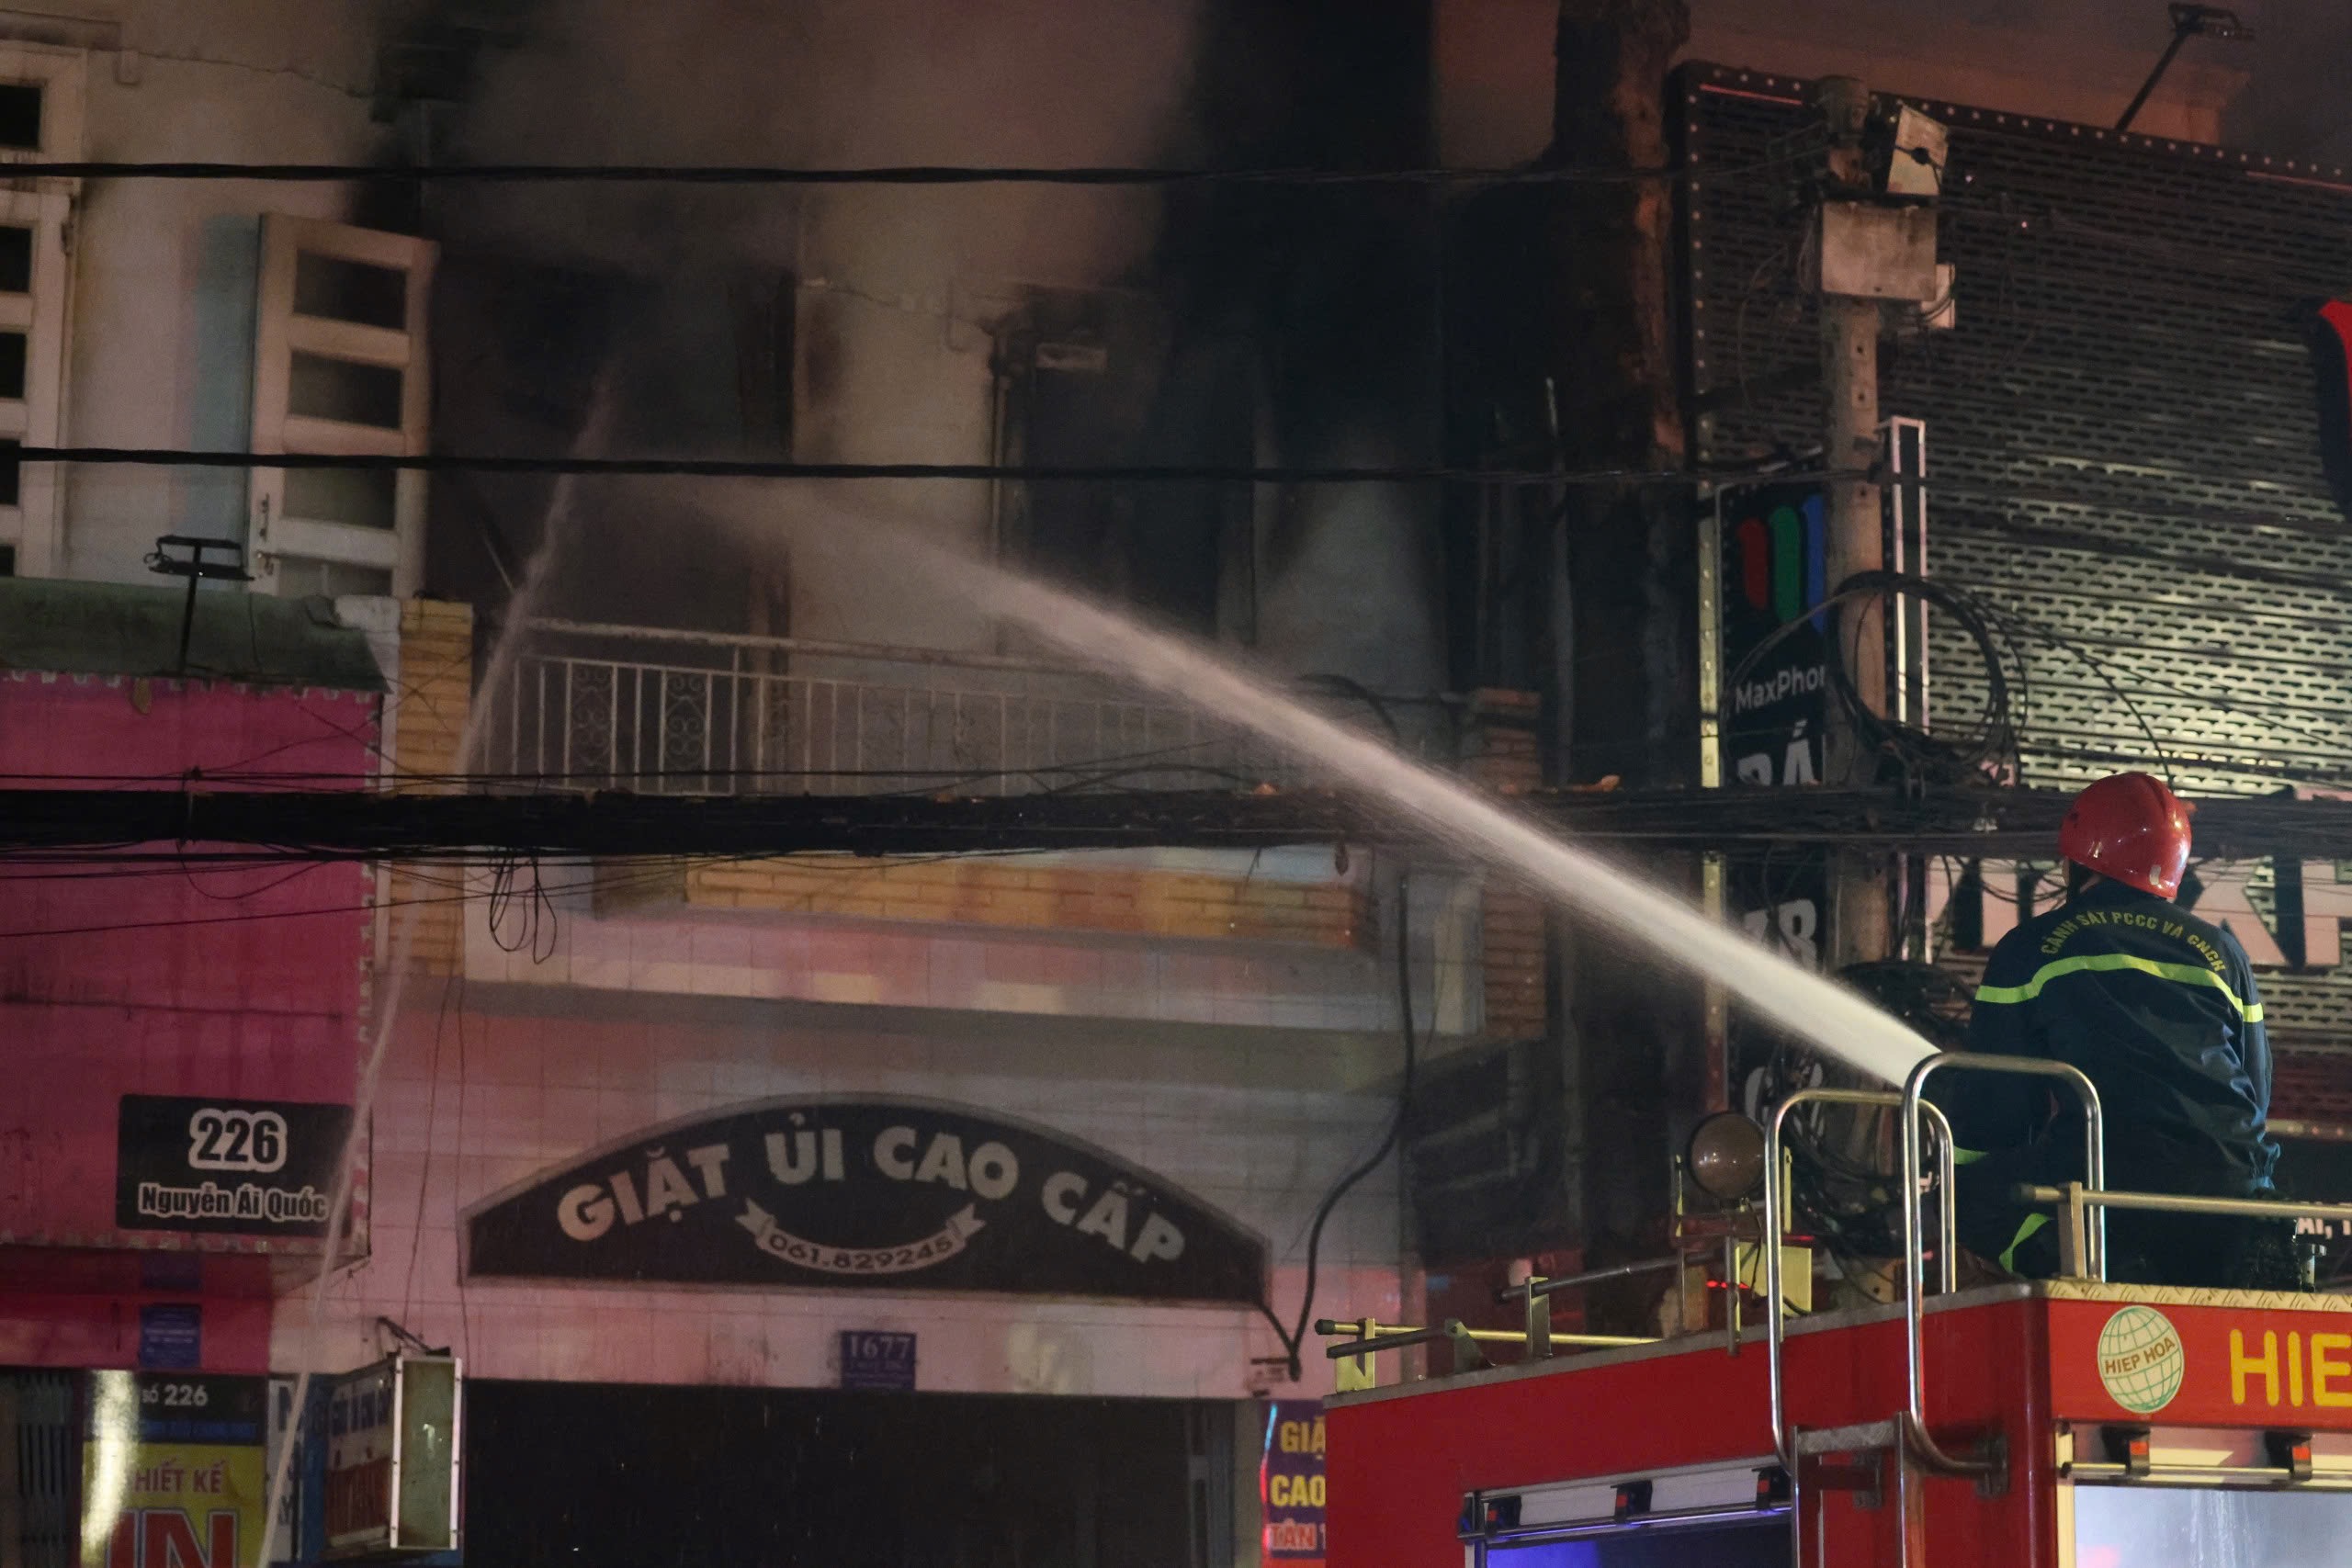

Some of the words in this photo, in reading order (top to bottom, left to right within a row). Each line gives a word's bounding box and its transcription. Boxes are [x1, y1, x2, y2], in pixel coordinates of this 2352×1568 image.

[2111, 912, 2157, 930] PCCC
[190, 1110, 286, 1170] 226
[140, 1182, 233, 1219] Nguyễn
[234, 1183, 264, 1218] Ái
[266, 1187, 329, 1223] Quốc
[557, 1145, 730, 1242] GIẶT
[764, 1112, 845, 1185] ỦI
[874, 1125, 1019, 1200] CAO
[1042, 1179, 1186, 1264] CẤP
[850, 1336, 911, 1359] 1677
[2105, 1355, 2141, 1375] HIEP
[2143, 1337, 2176, 1364] HOA
[2230, 1329, 2352, 1406] HIE
[164, 1384, 209, 1406] 226
[134, 1457, 186, 1493] HIẾT
[1270, 1474, 1326, 1507] CAO
